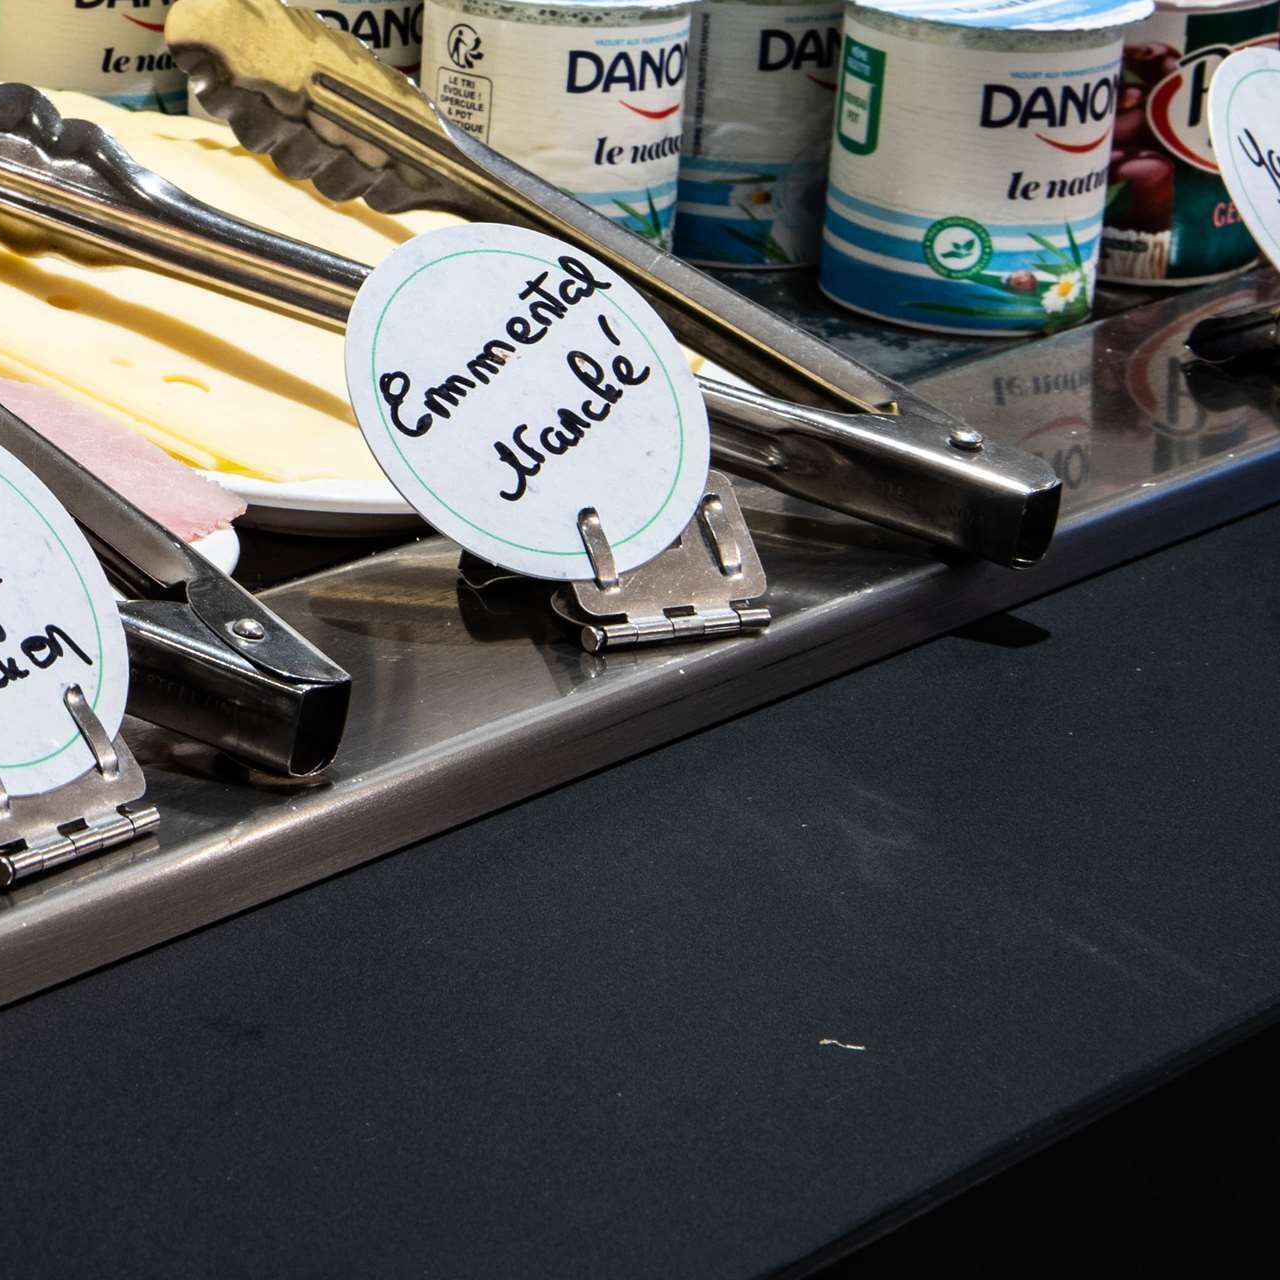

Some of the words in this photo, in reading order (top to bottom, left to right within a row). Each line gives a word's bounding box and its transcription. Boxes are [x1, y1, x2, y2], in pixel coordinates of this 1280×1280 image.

[101, 47, 131, 74] le
[566, 41, 688, 94] DANO
[448, 75, 459, 85] LE
[460, 78, 476, 89] TRI
[455, 110, 473, 121] POT
[979, 73, 1121, 129] DANO
[594, 136, 624, 166] le
[1007, 171, 1040, 201] le
[379, 254, 612, 438] Emmental
